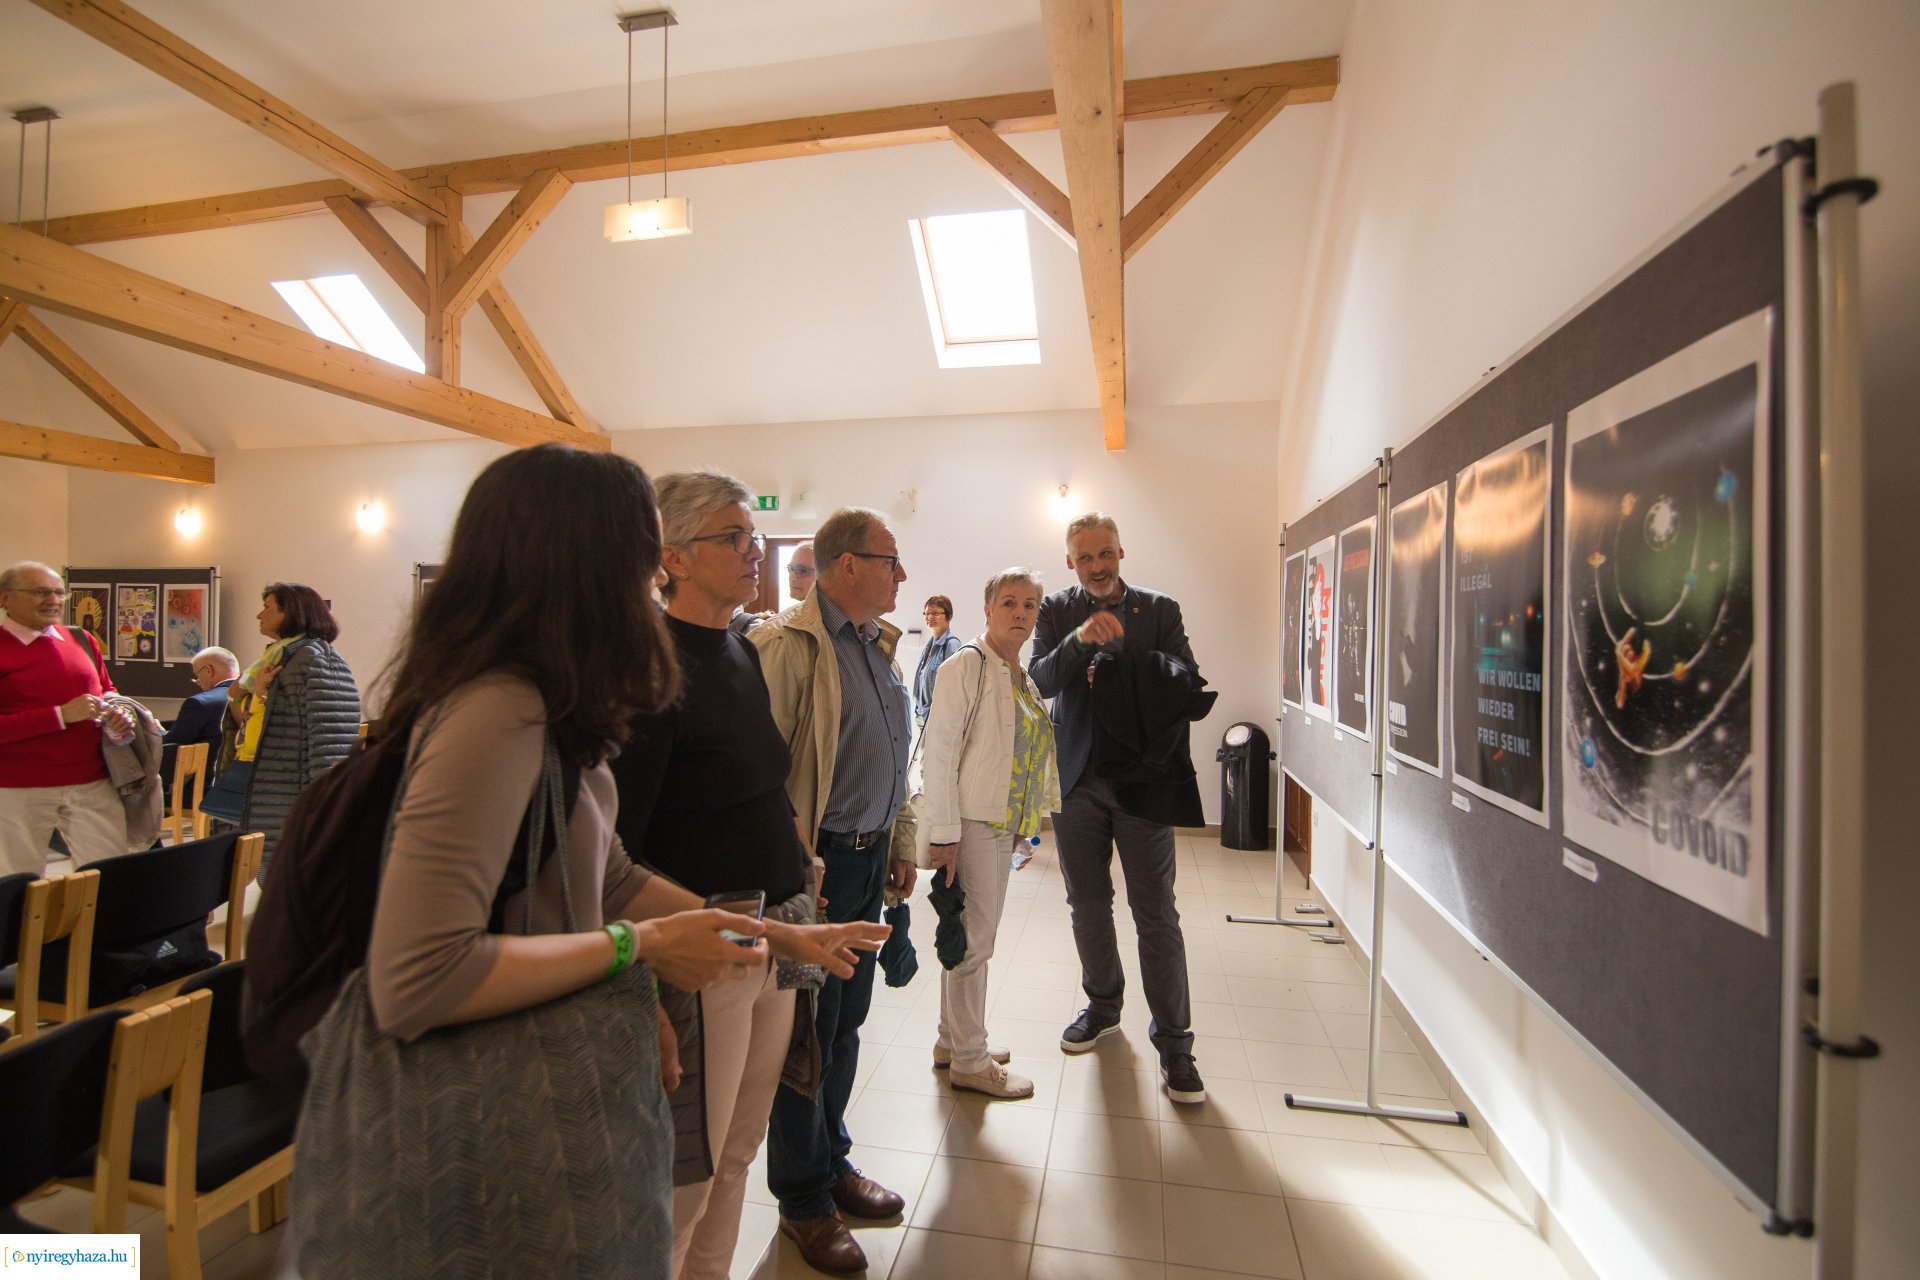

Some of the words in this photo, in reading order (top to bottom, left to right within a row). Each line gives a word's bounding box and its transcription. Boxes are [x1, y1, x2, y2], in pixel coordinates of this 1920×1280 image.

[1460, 573, 1492, 592] ILLEGAL
[1478, 668, 1496, 686] WIR
[1498, 669, 1541, 692] WOLLEN
[1478, 697, 1514, 720] WIEDER
[1477, 726, 1498, 748] FREI
[1500, 732, 1530, 757] SEIN!
[1652, 802, 1747, 877] COVOID
